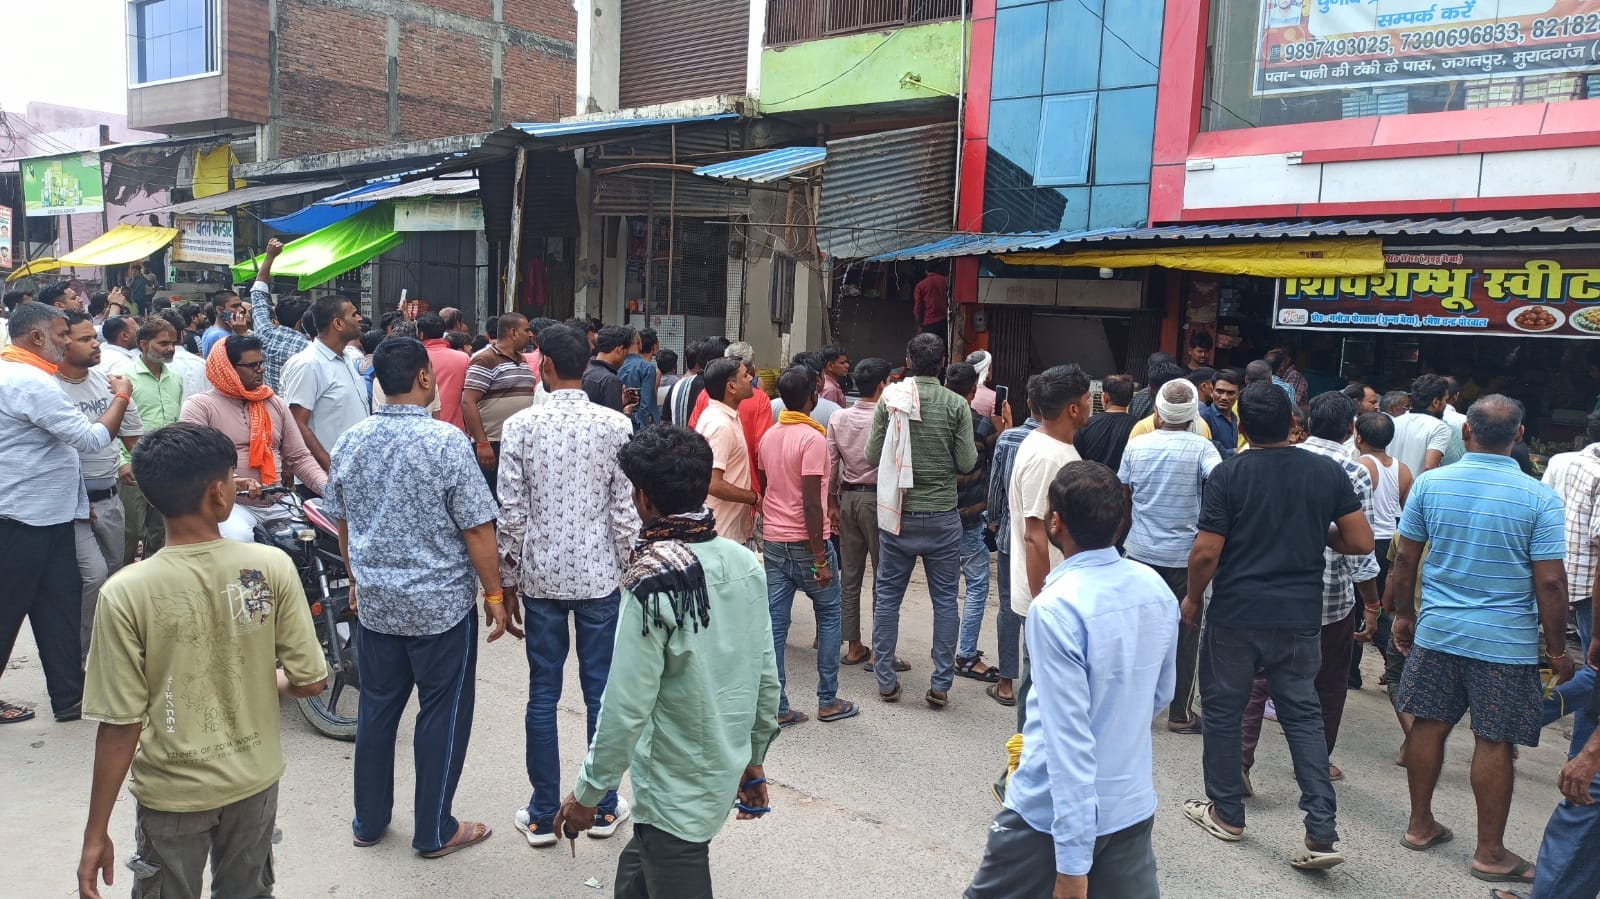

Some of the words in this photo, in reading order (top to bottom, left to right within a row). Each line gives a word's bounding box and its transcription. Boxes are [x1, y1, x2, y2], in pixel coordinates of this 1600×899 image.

[1378, 4, 1437, 27] सम्पर्क
[1441, 0, 1476, 20] करें
[1285, 35, 1394, 62] 9897493025,
[1400, 22, 1525, 51] 7300696833,
[1531, 12, 1600, 39] 82182
[1300, 66, 1328, 80] पानी
[1331, 61, 1349, 78] की
[1353, 59, 1381, 76] टंकी
[1384, 58, 1399, 73] के
[1442, 53, 1506, 71] जगतपुर,
[1513, 42, 1586, 69] मुरादगंज
